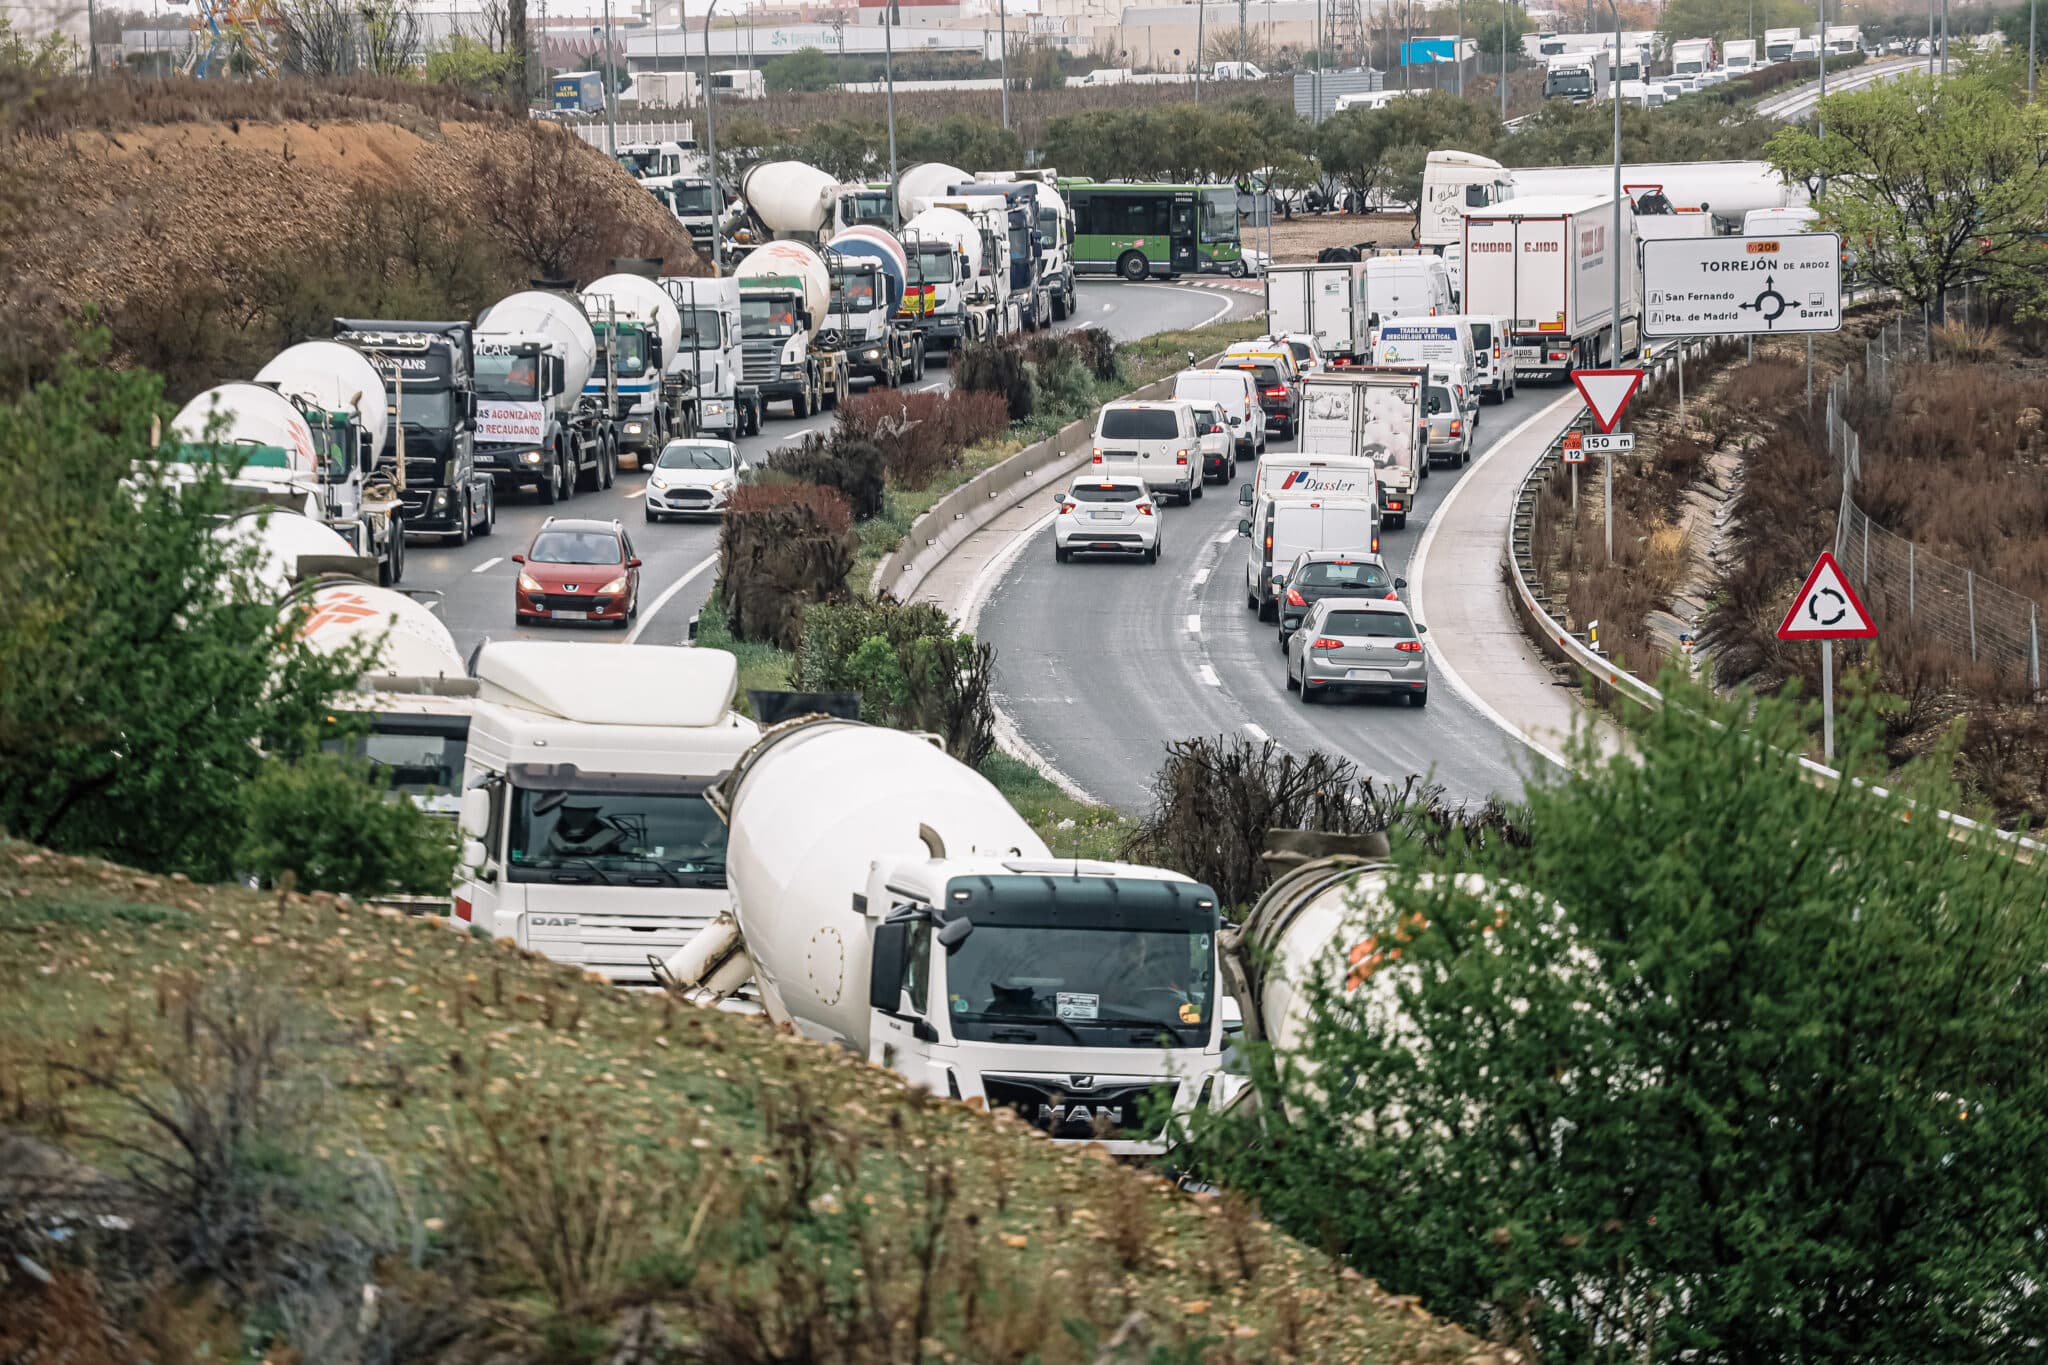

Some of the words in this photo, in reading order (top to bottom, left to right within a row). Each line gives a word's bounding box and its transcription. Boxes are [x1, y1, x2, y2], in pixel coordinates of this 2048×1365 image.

[1524, 241, 1558, 253] EJIDO
[1701, 256, 1778, 272] TORREJÓN
[1783, 262, 1795, 270] DE
[1800, 261, 1830, 269] ARDOZ
[1665, 293, 1684, 301] San
[1688, 291, 1735, 301] Fernando
[1665, 313, 1684, 322] Pta.
[1688, 313, 1700, 321] de
[1704, 311, 1738, 321] Madrid
[1800, 308, 1833, 318] Barral
[491, 409, 542, 421] AGONIZANDO
[486, 424, 540, 436] RECAUDANDO
[1586, 437, 1610, 449] 150
[1619, 438, 1630, 447] m
[1568, 450, 1580, 459] 12
[1304, 478, 1355, 492] Dassler
[531, 916, 577, 926] DAF
[1039, 1103, 1123, 1123] MAN
